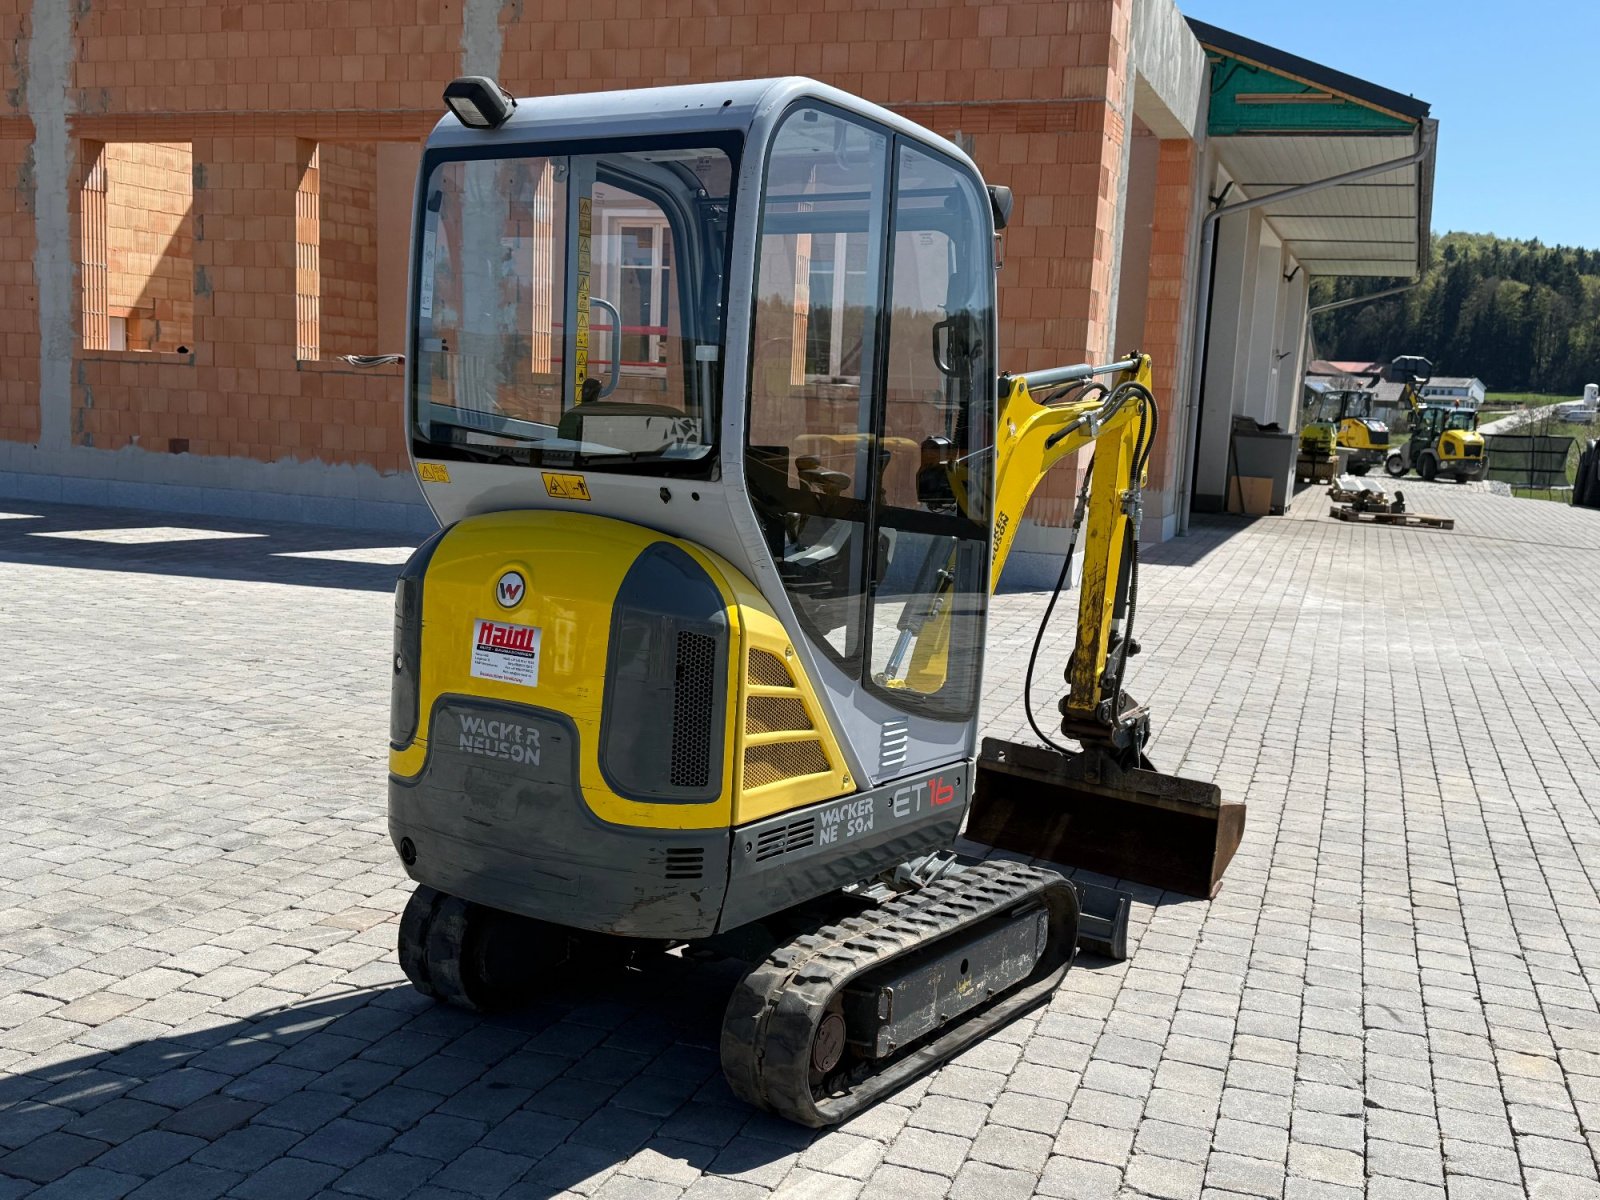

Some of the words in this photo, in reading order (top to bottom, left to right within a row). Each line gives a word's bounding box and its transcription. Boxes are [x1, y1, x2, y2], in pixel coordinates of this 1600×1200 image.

[459, 714, 541, 747] WACKER
[459, 733, 541, 766] NEUSON
[820, 798, 874, 828] WACKER
[893, 777, 954, 818] ET16
[820, 813, 874, 846] NESON
